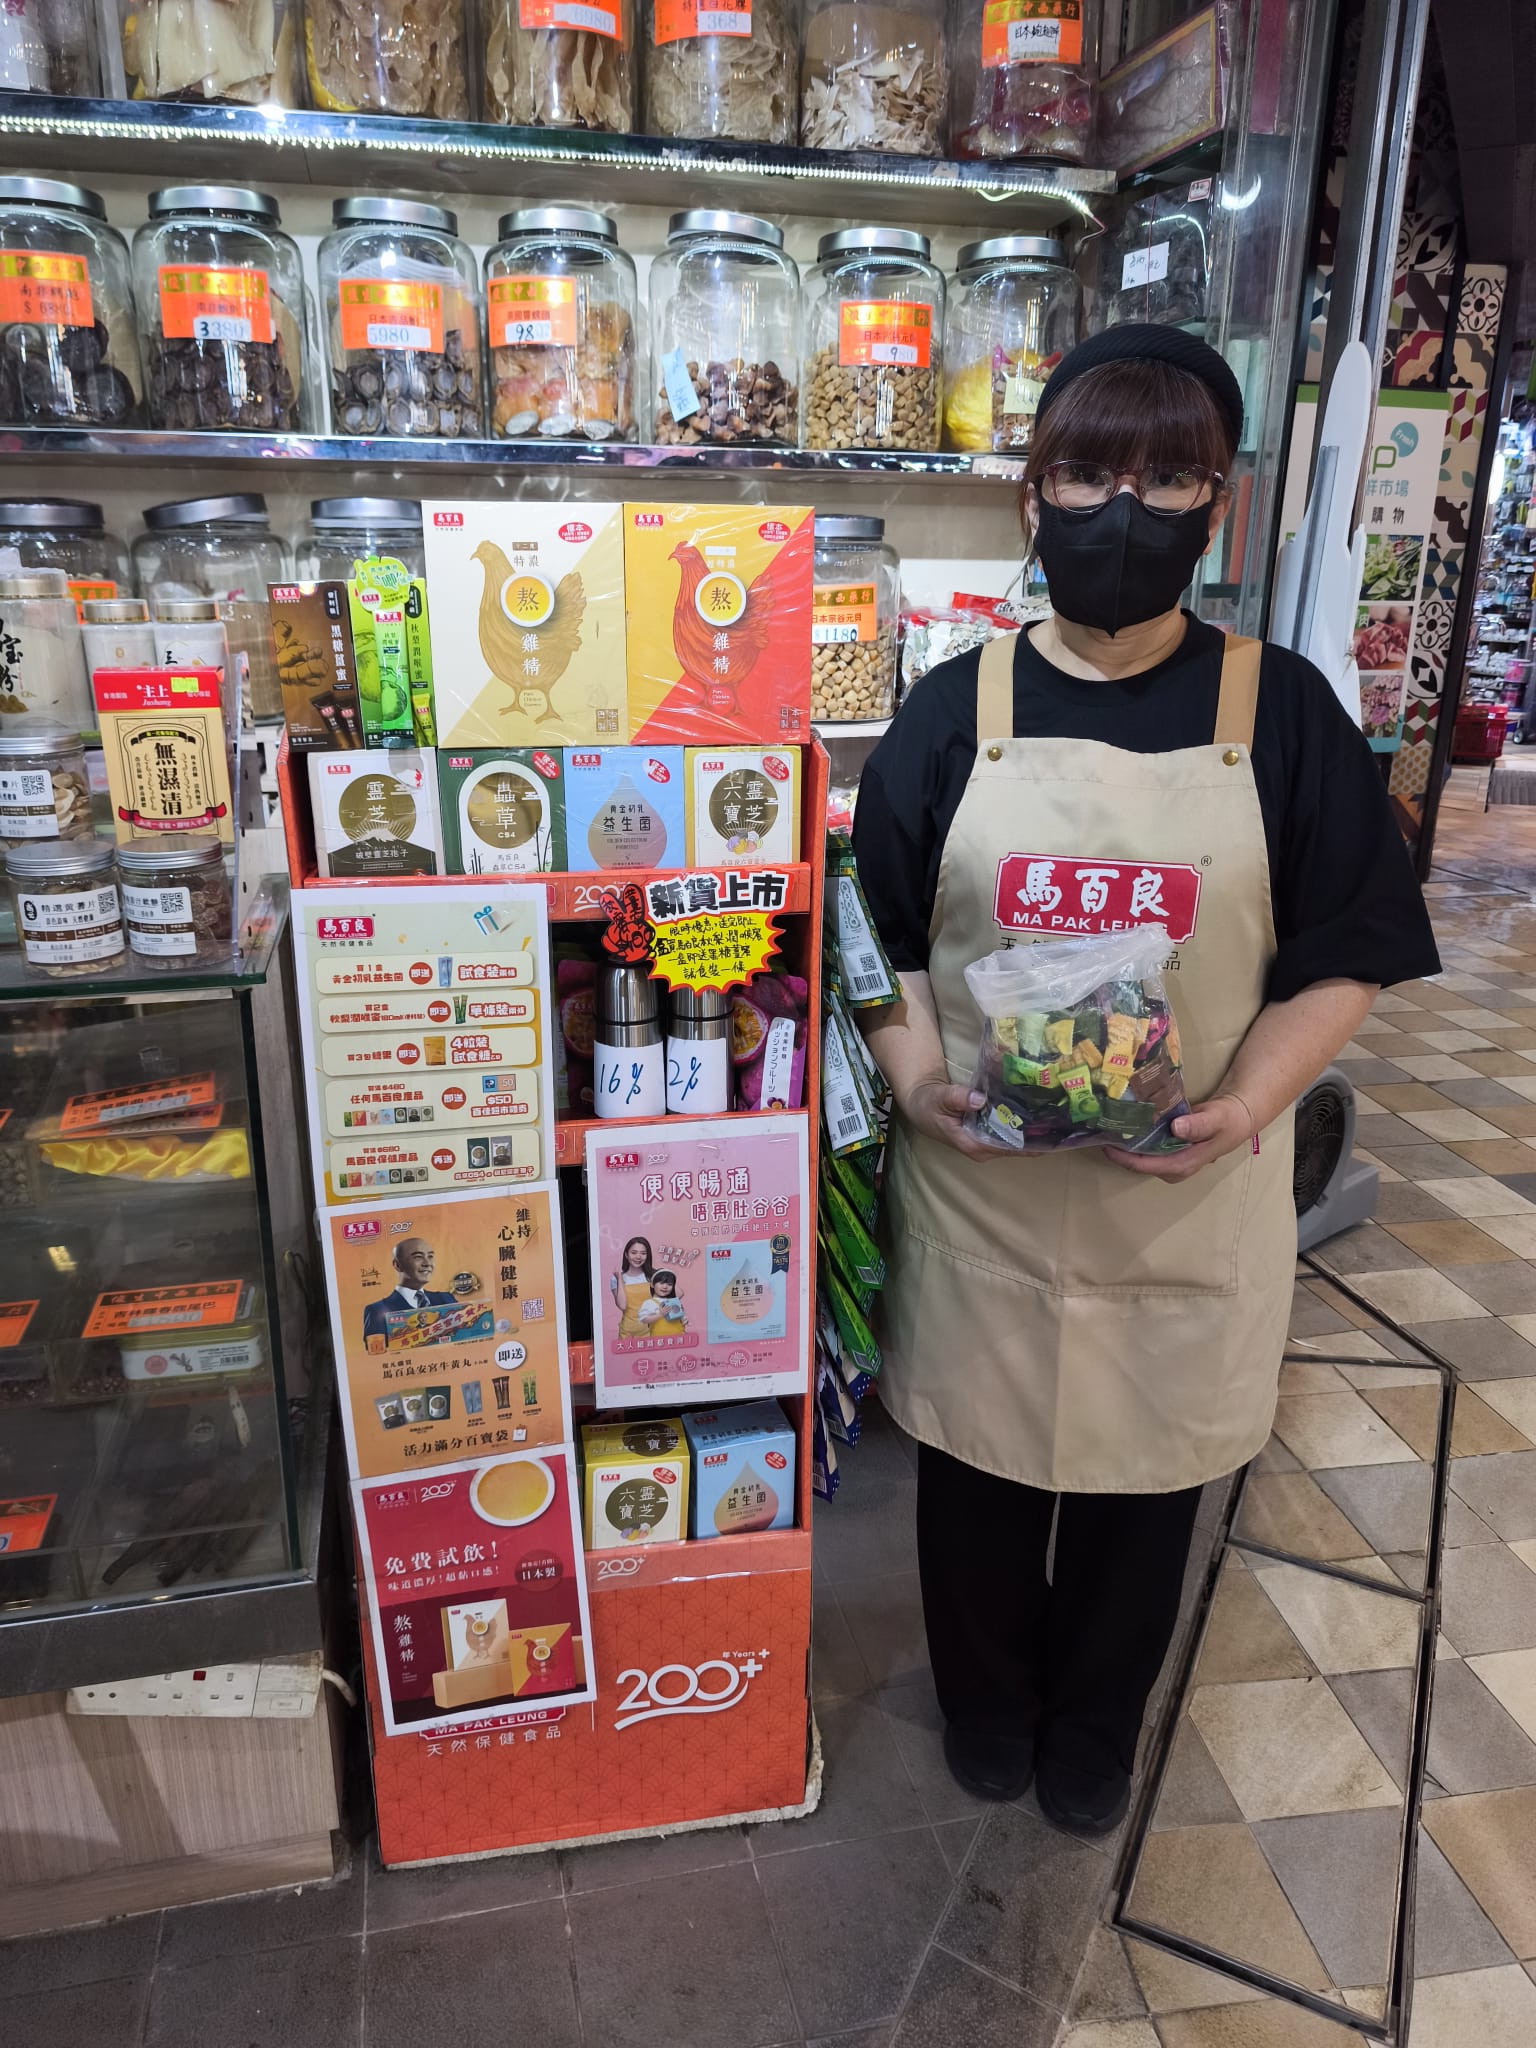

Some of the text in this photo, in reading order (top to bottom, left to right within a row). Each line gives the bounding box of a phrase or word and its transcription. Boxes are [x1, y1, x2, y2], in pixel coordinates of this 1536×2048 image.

[707, 14, 738, 30] 368
[517, 587, 540, 611] 熬
[711, 587, 732, 611] 熬
[521, 633, 541, 676] 雞精
[712, 633, 730, 675] 雞精
[155, 743, 182, 815] 無濕清
[366, 781, 388, 823] 靈芝
[603, 816, 651, 832] 益生菌
[648, 873, 785, 919] 新貨上市
[1016, 861, 1170, 917] 馬百良
[323, 919, 367, 934] 馬百良
[1012, 911, 1043, 926] MA
[1051, 914, 1091, 930] PAK
[332, 973, 404, 984] 黃金初乳益生菌
[486, 1095, 513, 1105] $50
[433, 1154, 453, 1165] 再送
[640, 1167, 749, 1203] 便便暢通
[691, 1197, 790, 1223] 唔再肚谷谷
[516, 1208, 532, 1239] 維持
[497, 1225, 520, 1301] 心臟健康
[731, 1285, 764, 1297] 益生菌
[498, 1346, 525, 1363] 即送
[403, 1429, 510, 1457] 活力滿分百寶袋
[727, 1495, 766, 1510] 益生菌
[522, 1567, 557, 1581] 日本製
[616, 1658, 763, 1712] 200+
[463, 1719, 494, 1731] PAK
[499, 1710, 548, 1726] LEUNG
[427, 1725, 561, 1758] 天然保健食品
